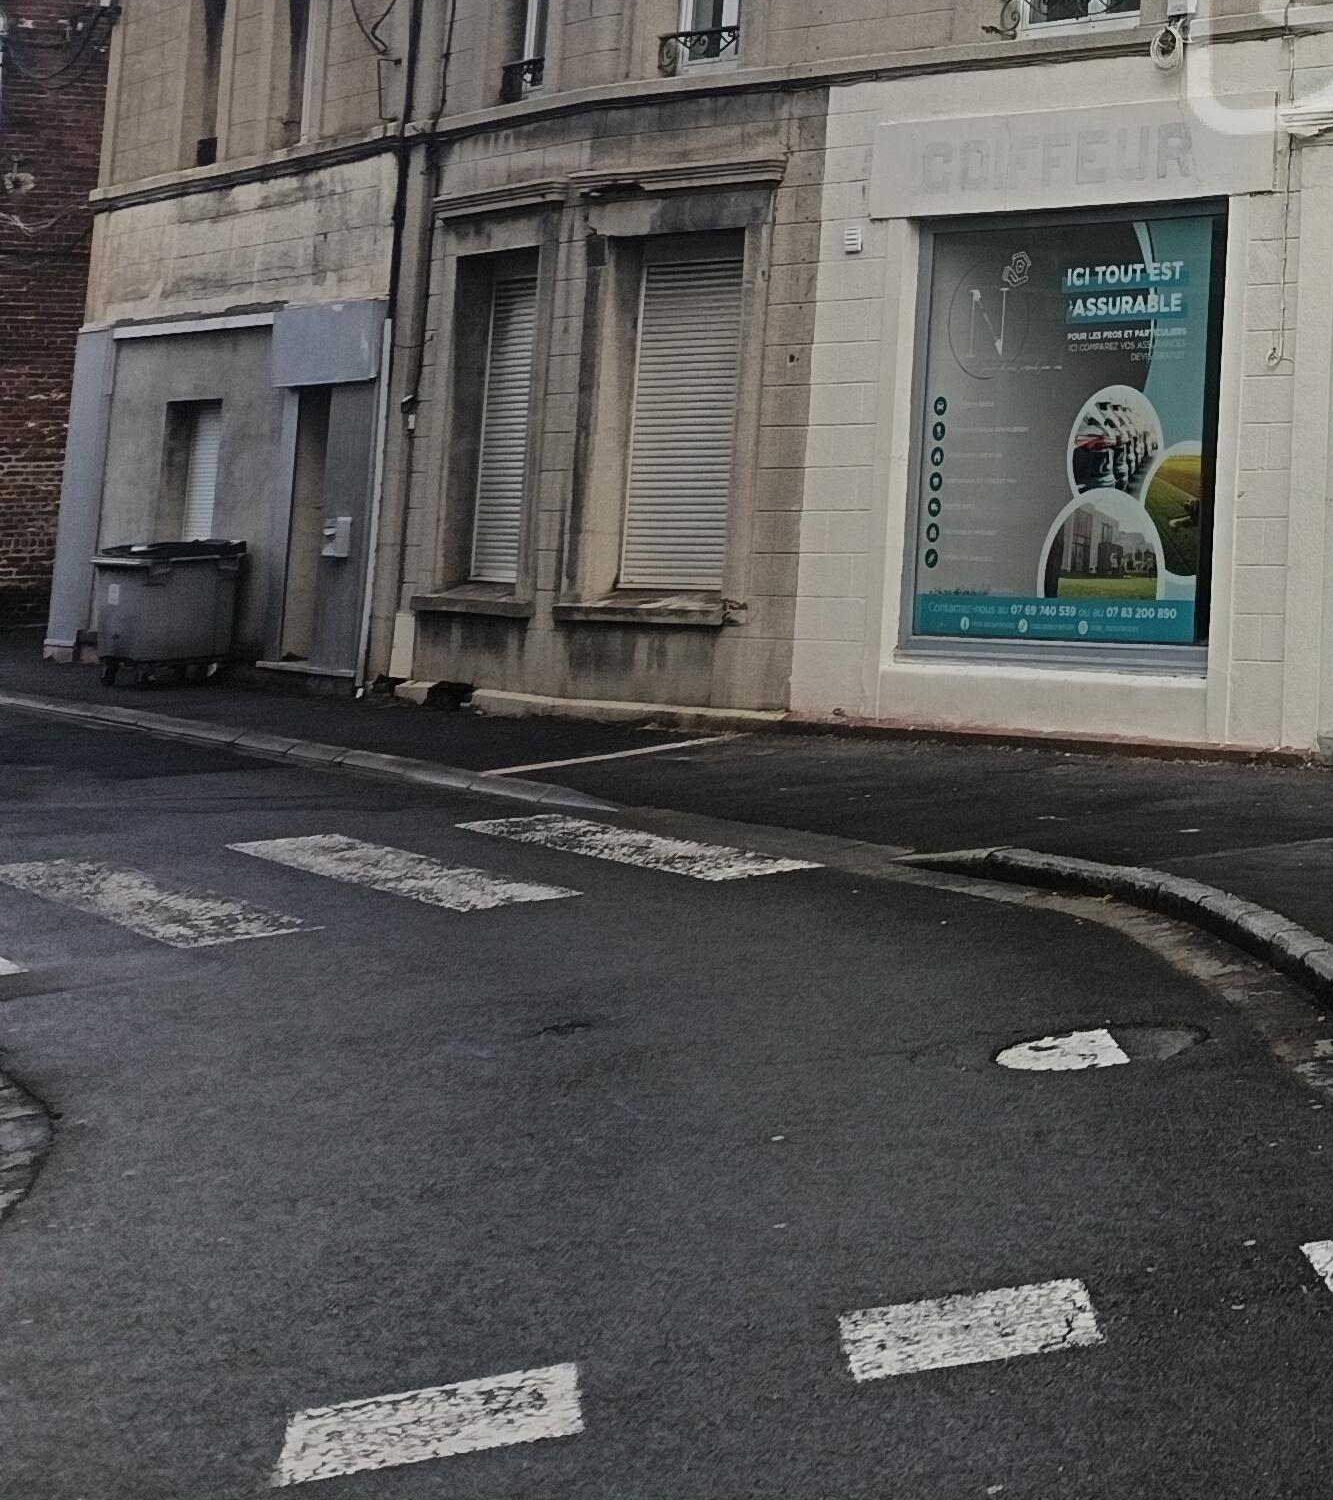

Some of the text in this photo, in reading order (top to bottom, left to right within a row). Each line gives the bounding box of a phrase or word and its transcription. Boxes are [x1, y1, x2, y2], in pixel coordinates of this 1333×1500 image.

[922, 122, 1193, 194] COIFFEUR
[1066, 261, 1184, 287] ICI TOUT EST
[1071, 293, 1182, 317] ASSURABLE
[1067, 332, 1087, 340] POUR
[1088, 331, 1102, 339] LES
[1103, 330, 1122, 339] PROS
[1123, 329, 1133, 338] ET
[1010, 605, 1023, 615] 07
[1024, 605, 1037, 616] 69
[1039, 605, 1057, 616] 740
[1058, 606, 1077, 617] 539
[1105, 607, 1119, 617] 07
[1120, 607, 1133, 618] 83
[1134, 608, 1155, 618] 200
